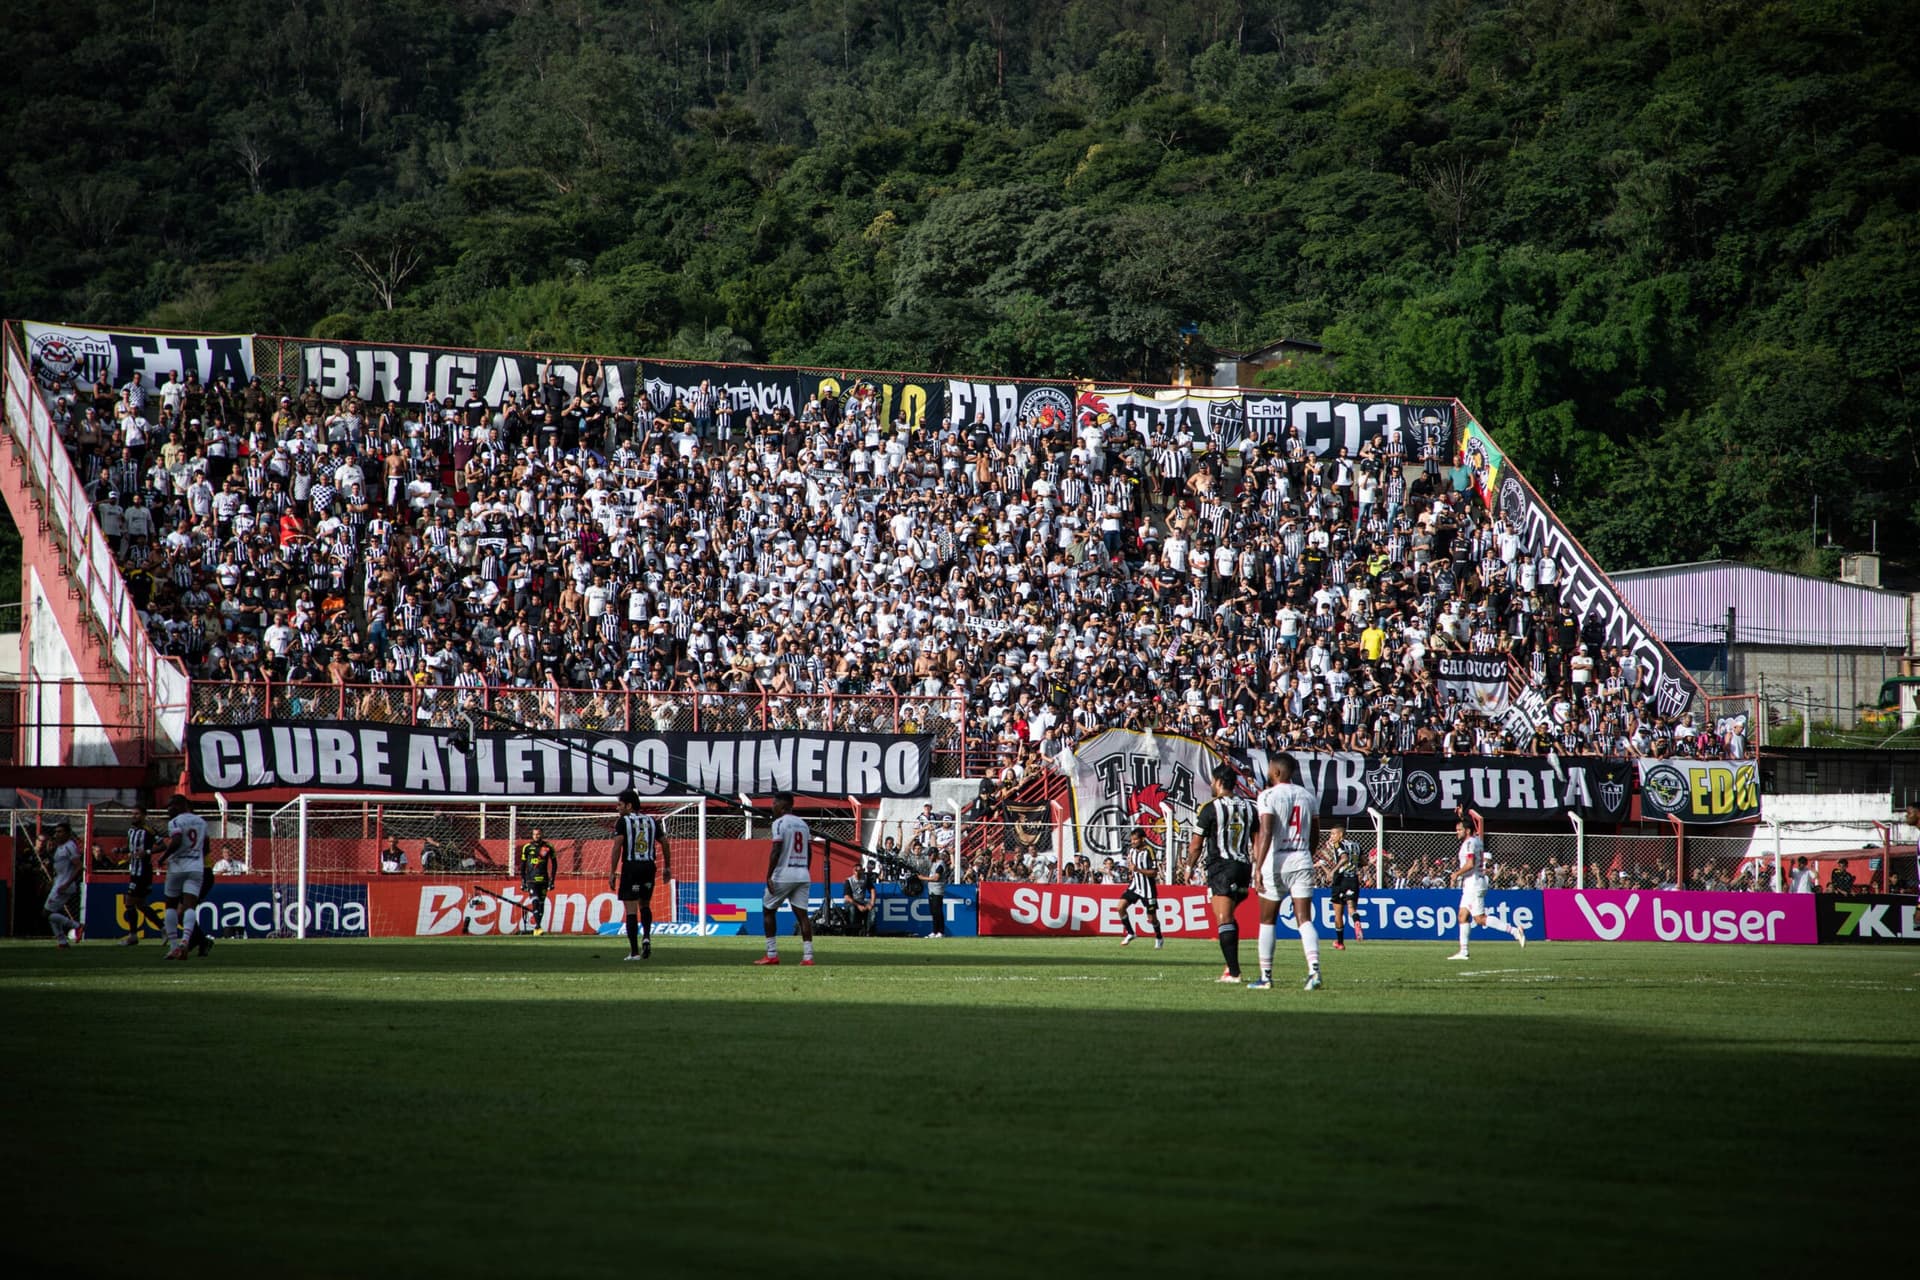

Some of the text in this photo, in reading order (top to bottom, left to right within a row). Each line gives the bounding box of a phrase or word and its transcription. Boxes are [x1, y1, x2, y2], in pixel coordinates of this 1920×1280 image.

[1117, 404, 1208, 443] TUA
[1251, 404, 1283, 415] CAM
[1292, 400, 1402, 457] C13
[1439, 658, 1508, 678] GALOUCOS
[200, 726, 392, 789] CLUBE
[686, 737, 920, 795] MINEIRO
[1228, 823, 1243, 849] 7
[1288, 805, 1302, 835] 4
[188, 828, 198, 849] 9
[635, 831, 648, 854] 6
[793, 831, 803, 854] 8
[416, 885, 624, 936] Betano
[1010, 887, 1213, 934] SUPERBE
[1321, 897, 1534, 937] BETesprte
[1653, 897, 1786, 942] buser
